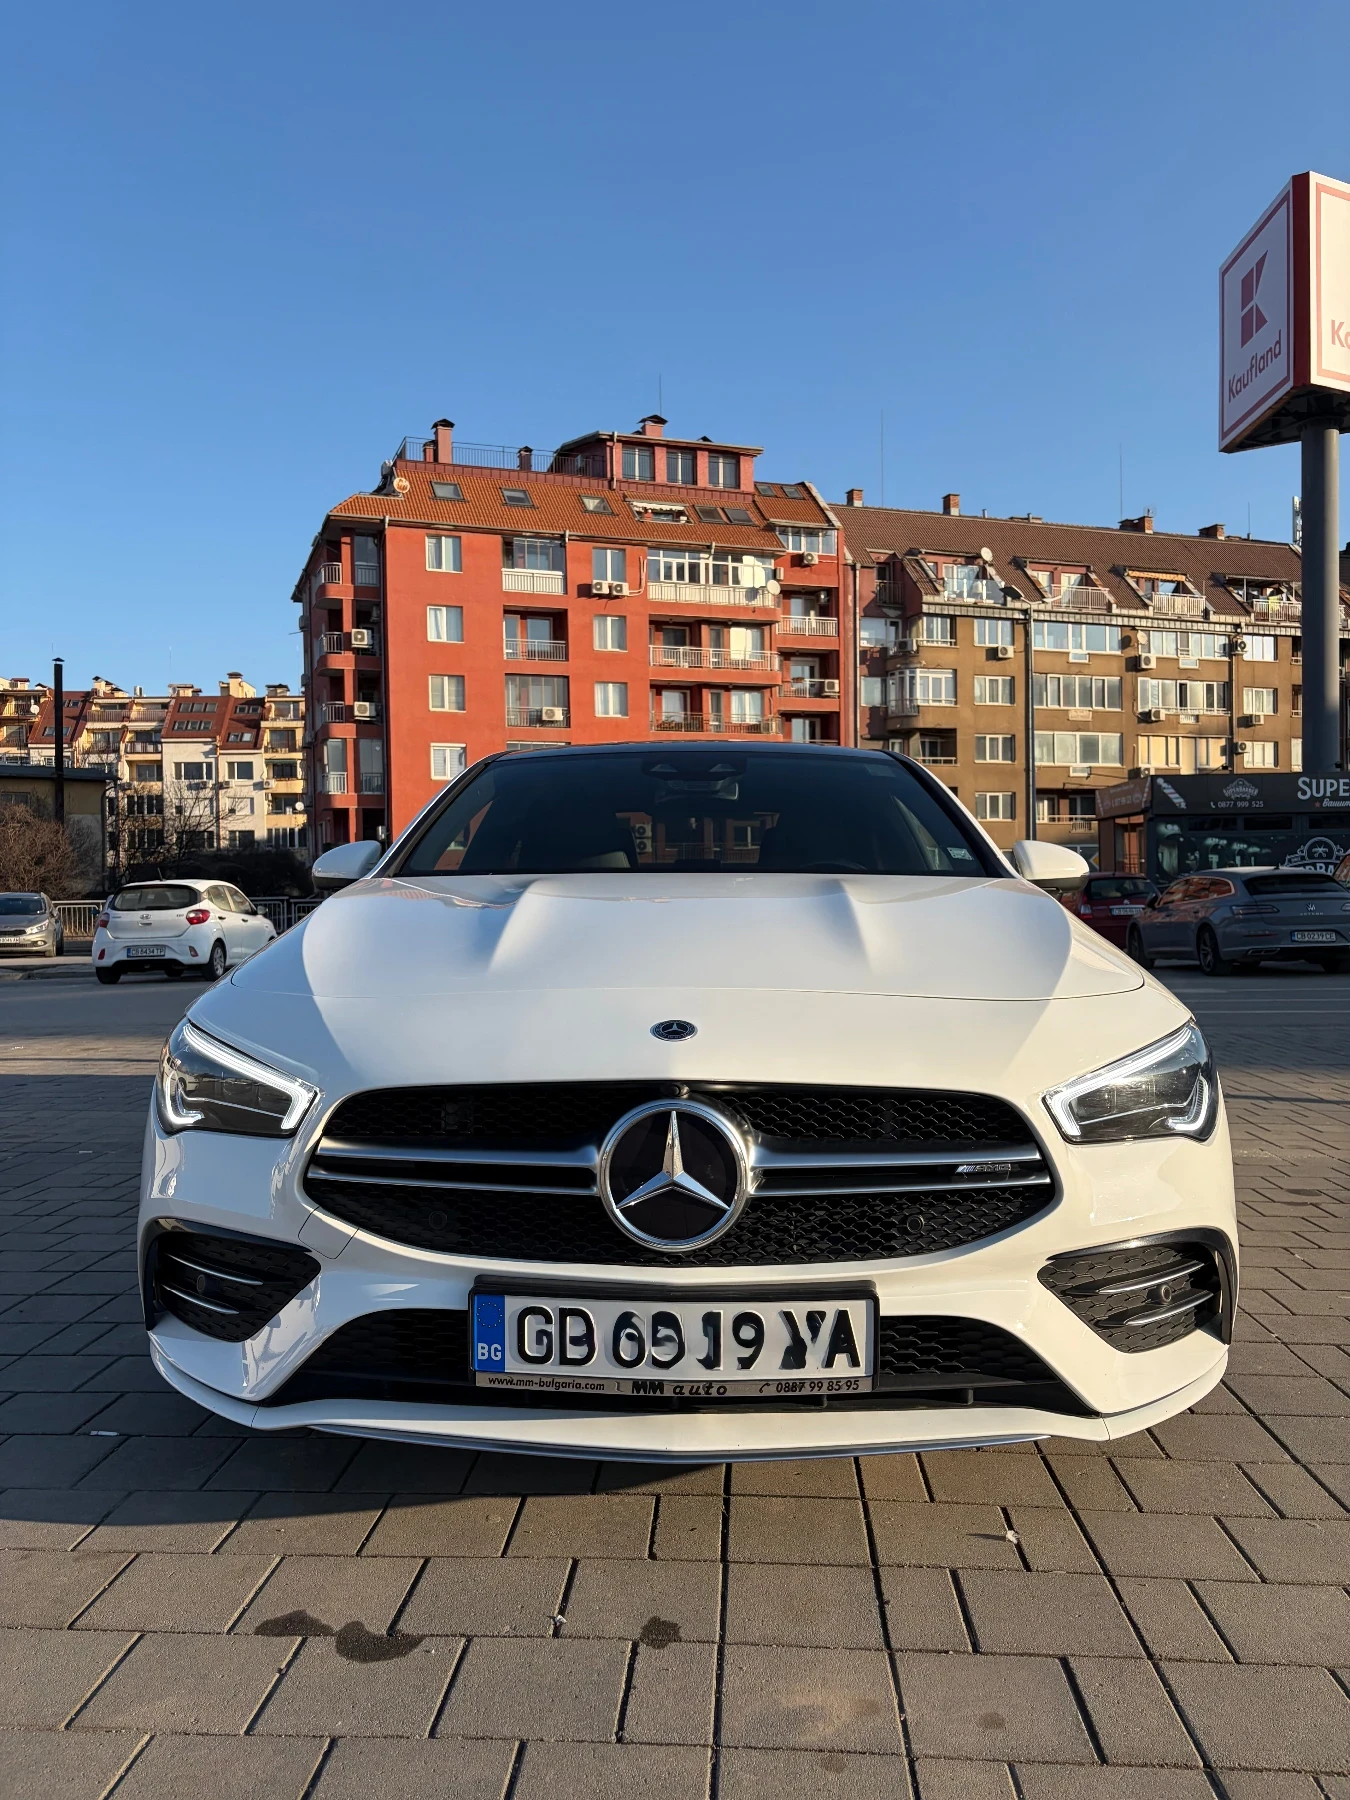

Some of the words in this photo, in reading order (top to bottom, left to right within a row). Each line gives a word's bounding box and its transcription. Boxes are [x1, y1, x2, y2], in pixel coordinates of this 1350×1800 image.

[1228, 329, 1282, 403] Kaufland
[1307, 932, 1324, 940] 0239
[974, 1164, 1011, 1172] AMG
[477, 1343, 502, 1360] BG
[488, 1376, 605, 1391] www.mm-bulgaria.com
[631, 1380, 665, 1394] MM
[672, 1382, 728, 1396] auto
[776, 1382, 806, 1393] 0887
[809, 1381, 823, 1392] 99
